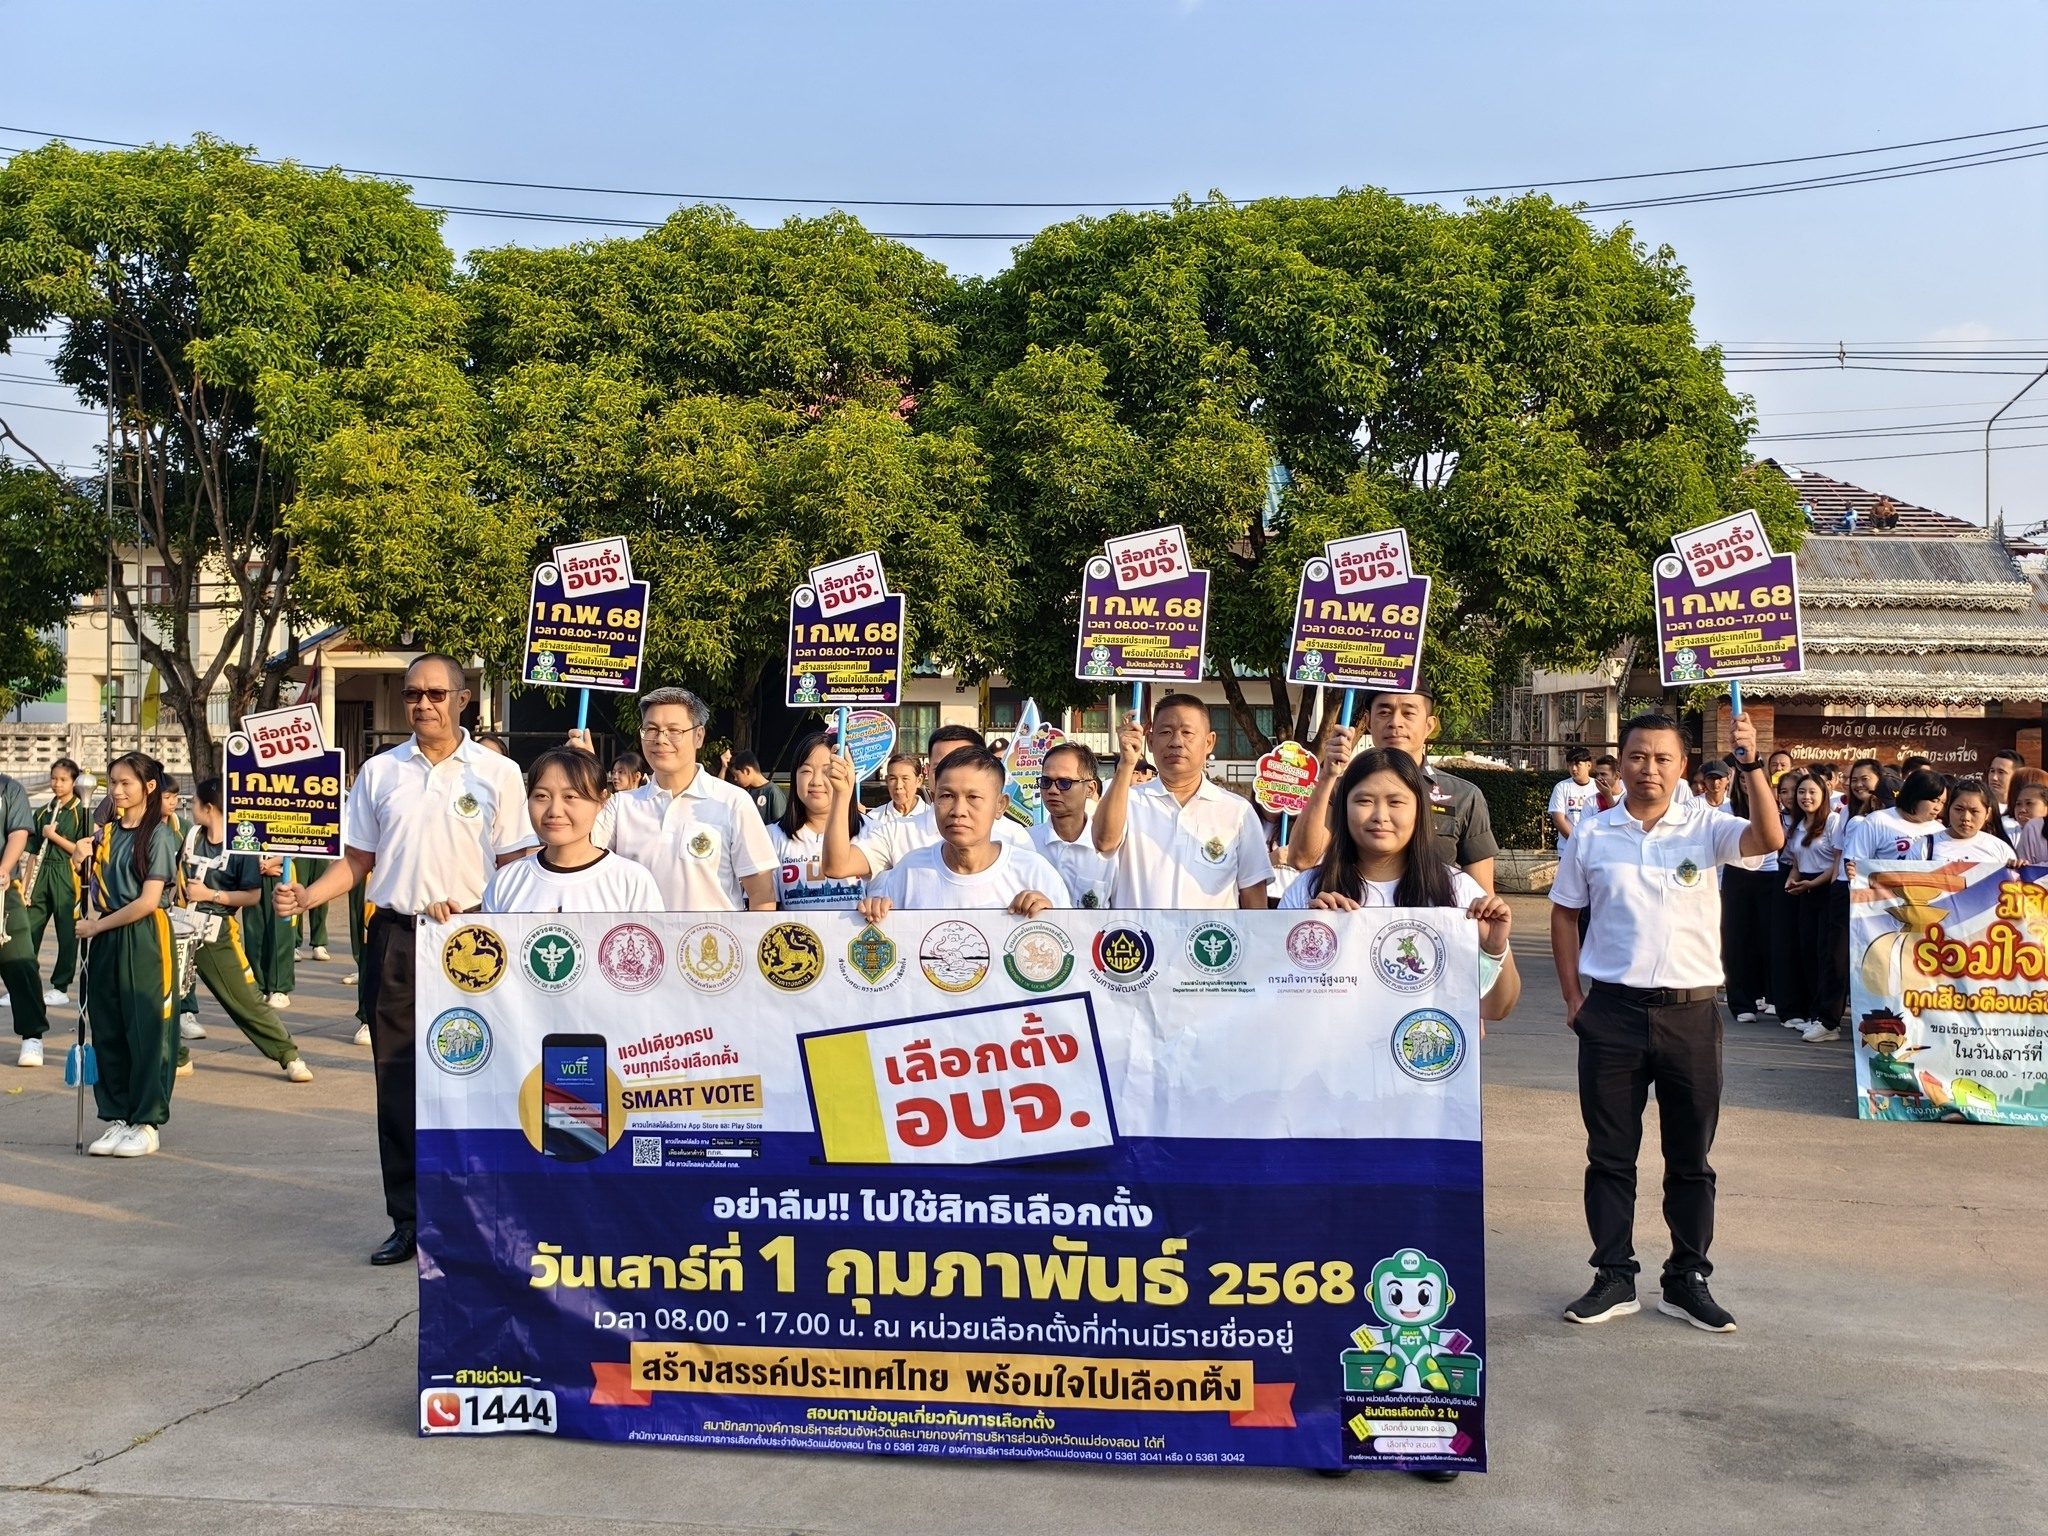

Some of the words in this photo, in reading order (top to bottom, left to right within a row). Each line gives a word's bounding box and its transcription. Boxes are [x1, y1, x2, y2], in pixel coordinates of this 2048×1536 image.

[1115, 538, 1177, 565] เลือกตั้ง
[1335, 542, 1399, 568] เลือกตั้ง
[1686, 526, 1754, 561] เลือกตั้ง
[563, 549, 621, 573] เลือกตั้ง
[1121, 557, 1182, 582] อบจ.
[1694, 545, 1763, 577] อบจ.
[568, 567, 624, 590] อบจ.
[819, 565, 874, 594] เลือกตั้ง
[1339, 562, 1402, 586] อบจ.
[824, 582, 879, 609] อบจ.
[1088, 596, 1098, 615] 1
[1105, 596, 1159, 616] ก.พ.
[1165, 598, 1201, 618] 68
[1662, 596, 1674, 617] 1
[1682, 590, 1745, 615] ก.พ.
[1750, 585, 1792, 608] 68
[536, 602, 546, 620] 1
[551, 603, 602, 625] ก.พ.
[607, 608, 641, 628] 68
[1304, 599, 1314, 618] 1
[1320, 600, 1376, 622] ก.พ.
[1381, 604, 1420, 625] 68
[1666, 622, 1692, 631] เวลา
[1780, 613, 1792, 621] น.
[535, 627, 556, 635] เวลา
[628, 634, 637, 642] น.
[795, 624, 804, 643] 1
[810, 623, 859, 643] ก.พ.
[864, 623, 897, 642] 68
[1088, 621, 1110, 629] เวลา
[1302, 624, 1325, 633] เวลา
[1404, 632, 1415, 640] น.
[539, 641, 608, 654] สร้างสรรค์ประเทศไทย
[1092, 636, 1168, 645] สร้างสรรค์ประเทศไทย
[1306, 641, 1382, 652] สร้างสรรค์ประเทศไทย
[1675, 631, 1759, 646] สร้างสรรค์ประเทศไทย
[796, 648, 816, 656] เวลา
[800, 662, 868, 671] สร้างสรรค์ประเทศไทย
[253, 717, 312, 742] เลือกตั้ง
[1822, 721, 1865, 737] คำขวัญ
[259, 736, 318, 759] อบจ.
[229, 772, 239, 791] 1
[246, 772, 300, 794] ก.พ.
[304, 776, 338, 796] 68
[231, 797, 253, 805] เวลา
[327, 801, 337, 809] น.
[237, 811, 309, 822] สร้างสรรค์ประเทศไทย
[524, 963, 541, 986] MINISTRY
[550, 981, 568, 989] PUBLIC
[568, 964, 582, 982] HEALTH
[1089, 967, 1159, 993] กรมการพัฒนาชุมชน
[1268, 974, 1358, 987] กรมกิจการผู้สูงอายุ
[1372, 956, 1391, 985] GOVERNMENT
[1392, 982, 1408, 990] PUBLIC
[1432, 948, 1444, 977] DEPARTMENT
[618, 1026, 714, 1060] แอปเดียวครบ
[885, 1012, 1079, 1085] เลือกตั้ง
[1954, 1040, 2043, 1062] ในวันเสาร์ที่
[561, 1064, 588, 1075] VOTE
[623, 1045, 739, 1079] จบทุกเรื่องเลือกตั้ง
[1956, 1068, 1977, 1077] เวลา
[1981, 1070, 2008, 1079] 08.00
[621, 1087, 695, 1110] SMART
[701, 1083, 755, 1104] VOTE
[895, 1082, 1091, 1147] อบจ.
[713, 1187, 850, 1221] อย่าลืม!!
[860, 1185, 1153, 1227] ไปใช้สิทธิเลือกตั้ง
[529, 1231, 743, 1292] วันเสาร์ที่
[759, 1235, 795, 1292] 1
[825, 1234, 1188, 1315] กุมภาพันธ์
[1207, 1260, 1355, 1305] 2568
[594, 1311, 646, 1329] เวลา
[655, 1308, 729, 1333] 08.00
[755, 1311, 830, 1336] 17.00
[839, 1317, 864, 1337] น.
[873, 1320, 900, 1338] ณ
[909, 1311, 1294, 1354] หน่วยเลือกตั้งที่ท่านมีรายชื่ออยู่
[1400, 1336, 1422, 1345] ECT
[455, 1366, 521, 1384] สายด่วน
[641, 1351, 948, 1392] สร้างสรรค์ประเทศไทย
[465, 1394, 552, 1426] 1444
[806, 1405, 1055, 1430] สอบถามข้อมูลเกี่ยวกับการเลือกตั้ง
[1365, 1404, 1435, 1417] รับบัตรเลือกตั้ง
[1438, 1409, 1444, 1417] 2
[1446, 1408, 1459, 1418] ใบ
[703, 1419, 1140, 1449] สมาชิกสภาองค์การบริหารส่วนจังหวัดและนายกองค์การบริหารส่วนจังหวัดแม่ฮ่องสอน
[1144, 1436, 1166, 1449] ได้ที่
[1382, 1422, 1408, 1432] เลือกตั้ง
[628, 1430, 864, 1450] สำนักงานคณะกรรมการการเลือกตั้งประจำจังหวัดแม่ฮ่องสอน
[866, 1440, 882, 1451] โทร
[884, 1443, 891, 1451] 0
[893, 1443, 915, 1452] 5361
[917, 1443, 940, 1453] 2878
[949, 1443, 1103, 1460] องค์การบริหารส่วนจังหวัดแม่ฮ่องสอน
[1105, 1451, 1112, 1460] 0
[1115, 1452, 1137, 1461] 5361
[1139, 1452, 1162, 1462] 3041
[1165, 1451, 1183, 1462] หรือ
[1185, 1453, 1193, 1461] 0
[1195, 1452, 1218, 1461] 5361
[1221, 1453, 1245, 1462] 3042
